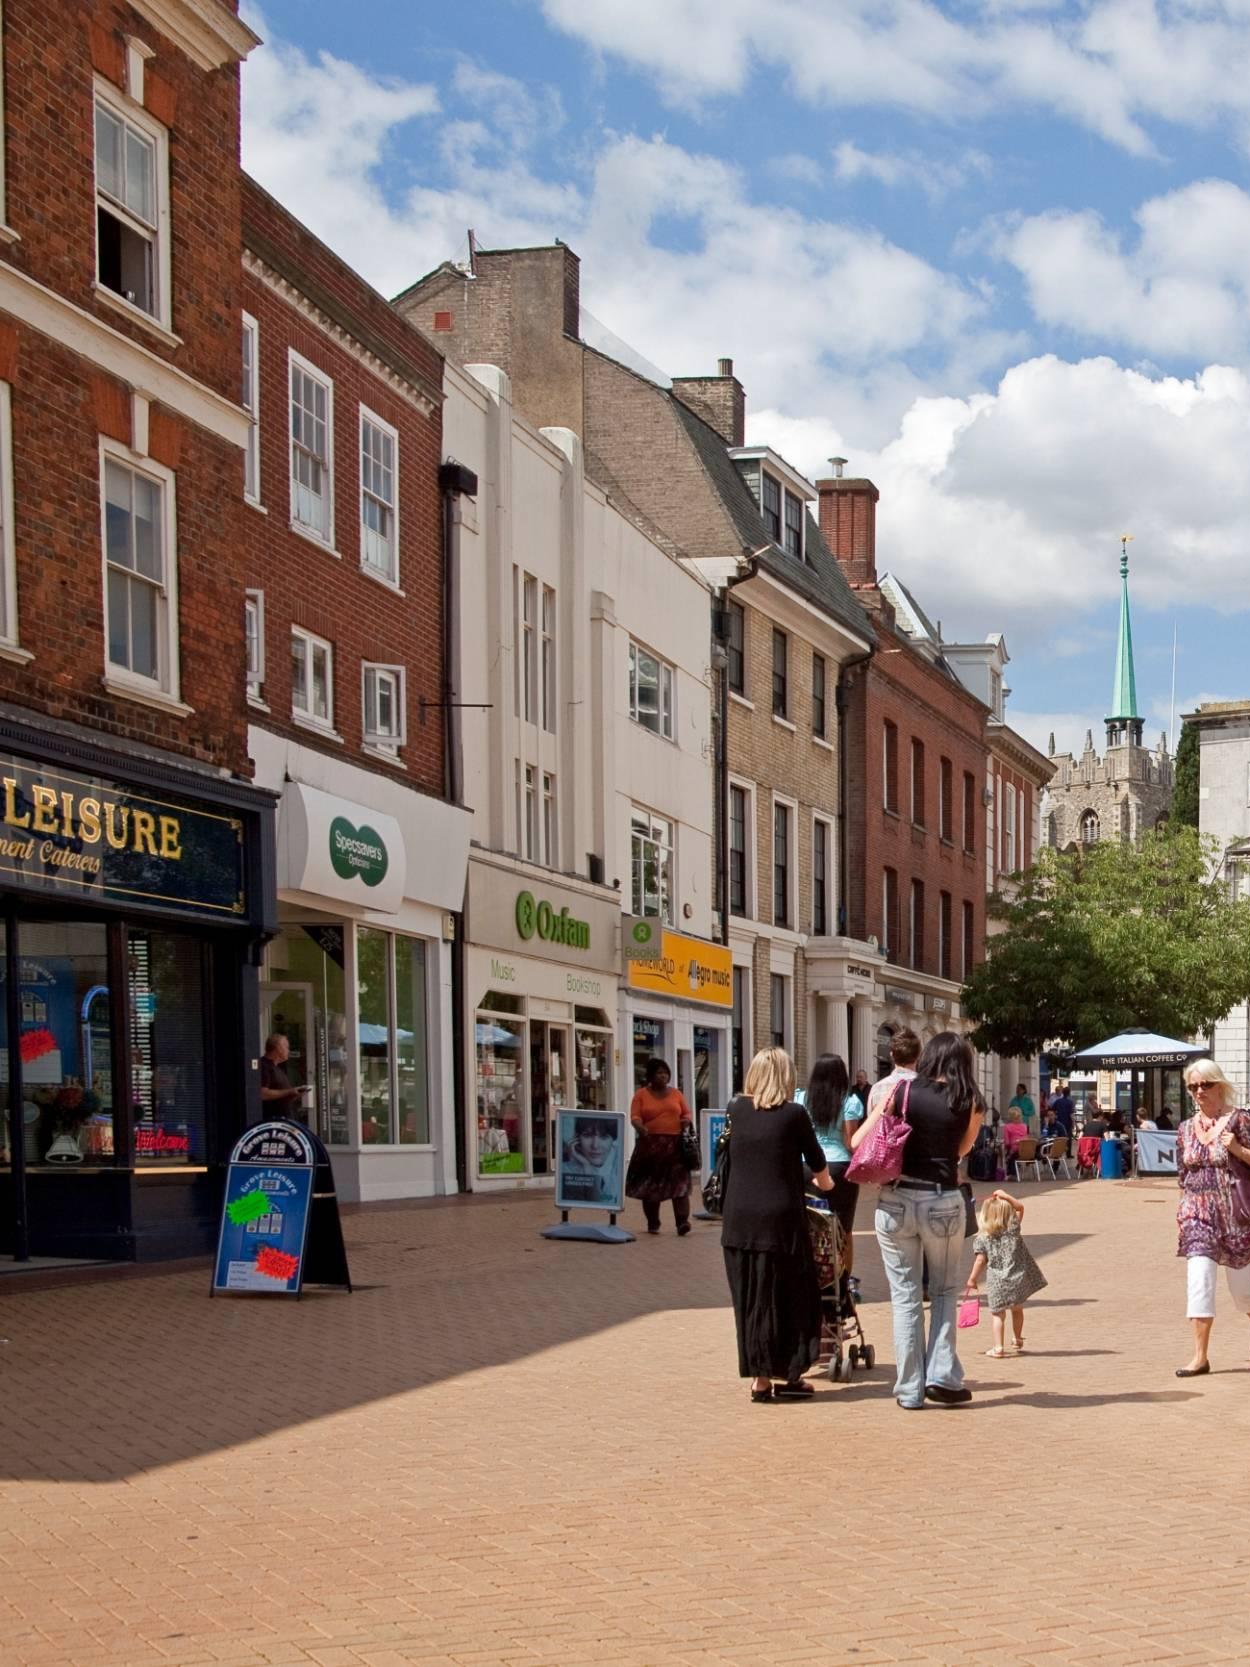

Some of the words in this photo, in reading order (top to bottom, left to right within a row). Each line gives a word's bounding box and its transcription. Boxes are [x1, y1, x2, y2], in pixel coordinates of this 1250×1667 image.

[3, 777, 182, 860] LEISURE
[39, 840, 100, 873] Caterers
[335, 830, 382, 861] Specsavers
[536, 900, 590, 951] Oxfam
[624, 947, 659, 958] Books
[491, 960, 515, 981] Music
[712, 969, 730, 987] music
[566, 973, 601, 999] Bookshop
[1101, 1057, 1115, 1065] THE
[1117, 1056, 1144, 1064] ITALIAN
[135, 1127, 190, 1151] Welcome
[242, 1132, 270, 1154] Grove
[272, 1130, 303, 1157] Leisure
[240, 1172, 265, 1193] Grove
[268, 1169, 298, 1195] Leisure
